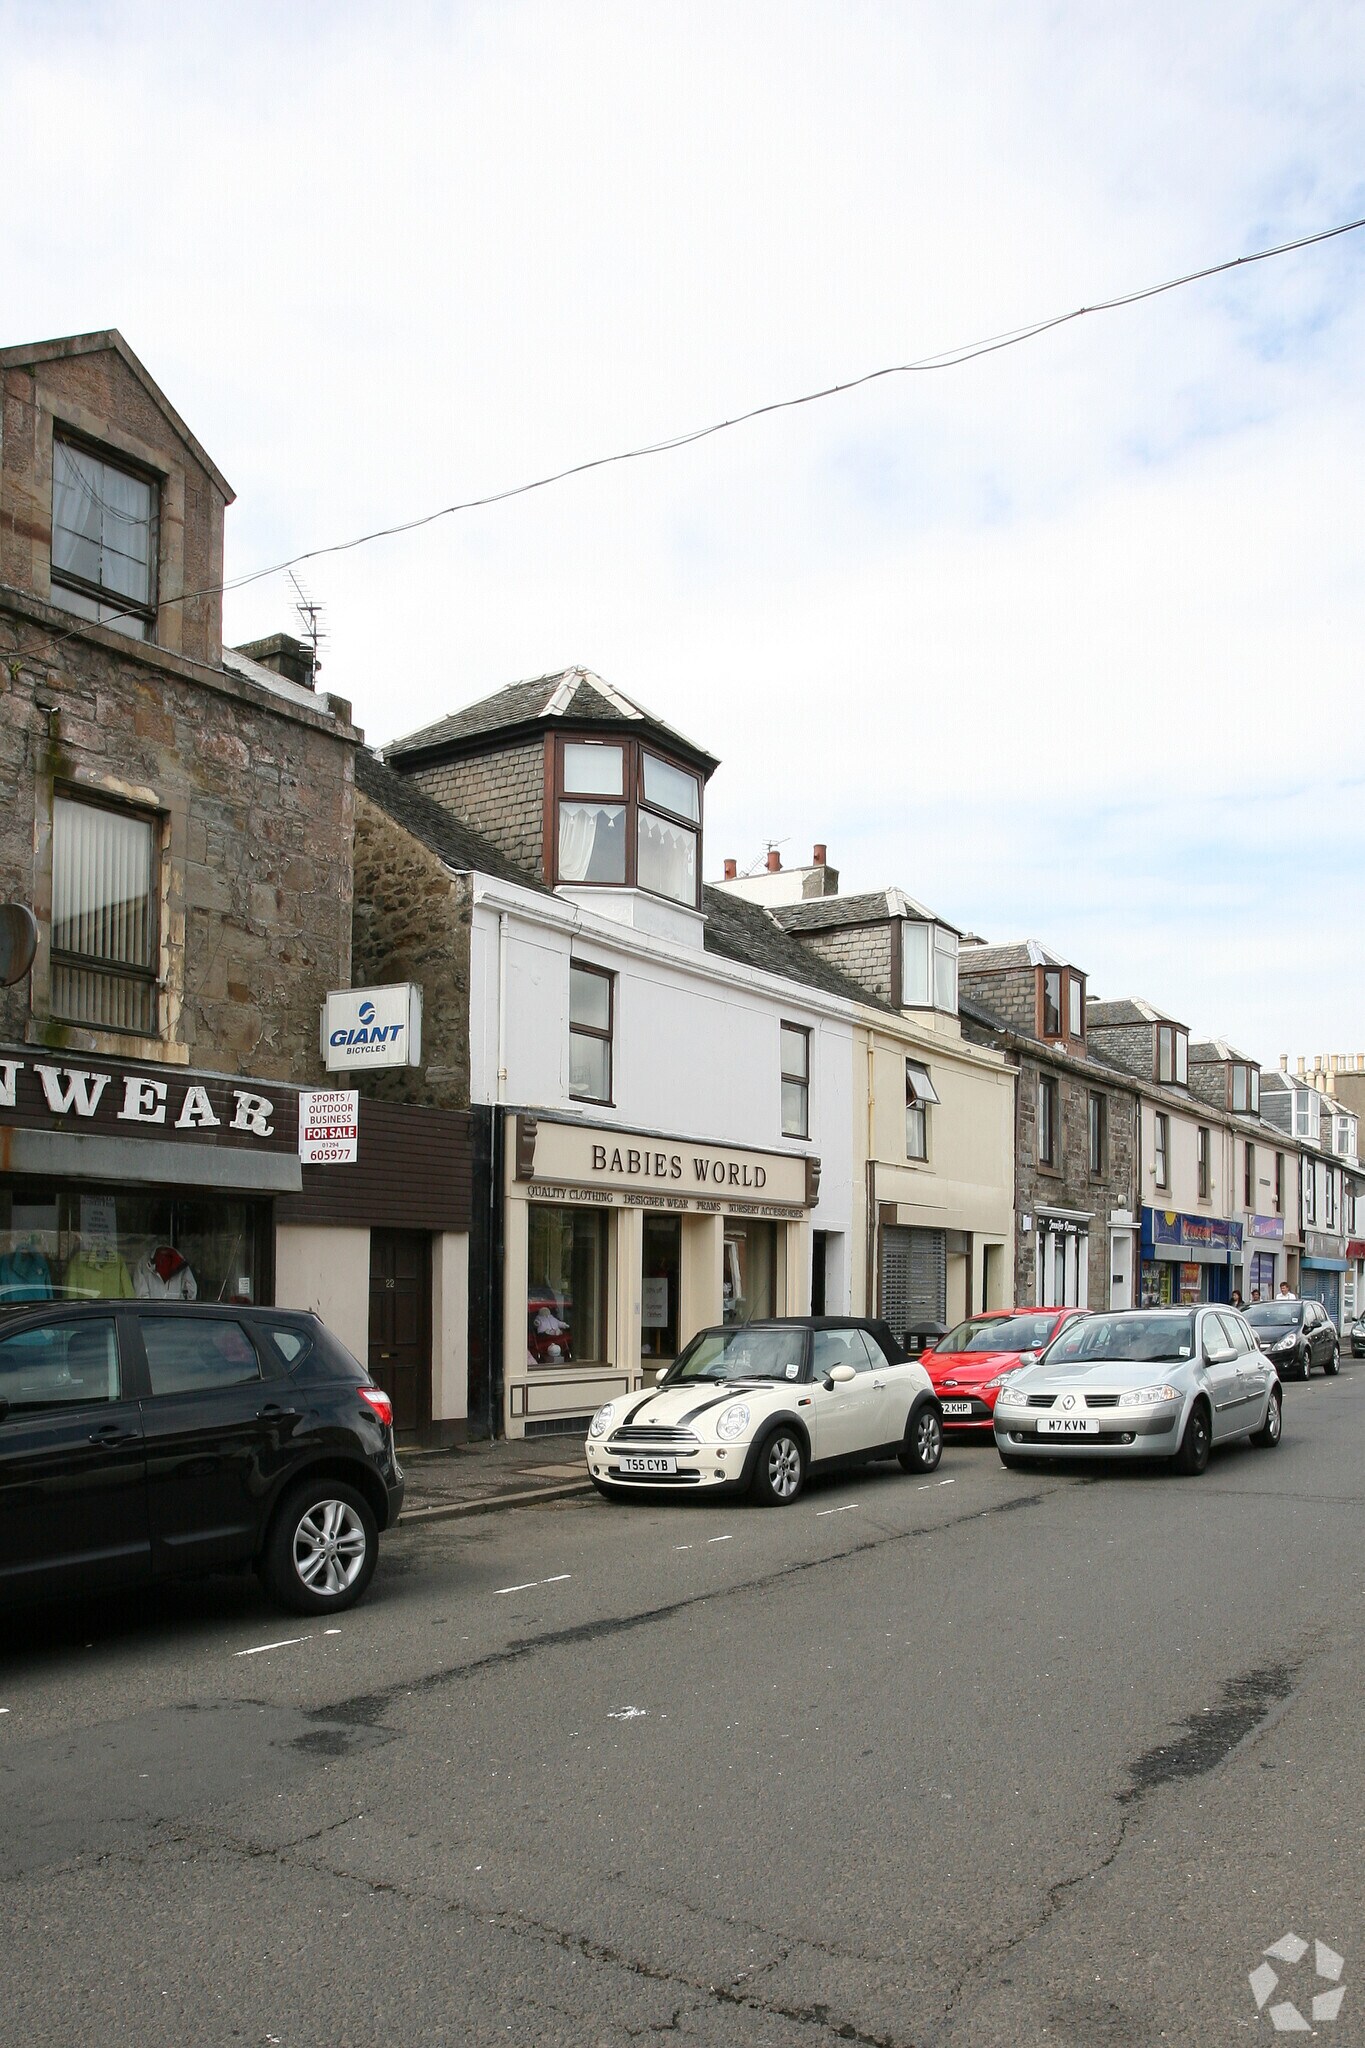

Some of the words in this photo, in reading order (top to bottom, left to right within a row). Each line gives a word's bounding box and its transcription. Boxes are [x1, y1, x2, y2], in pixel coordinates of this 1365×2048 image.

[330, 1025, 404, 1047] GIANT
[346, 1045, 386, 1054] BICYCLES
[312, 1094, 345, 1103] SPORTS
[309, 1104, 353, 1113] OUTDOOR
[310, 1115, 352, 1124] BUSINESS
[307, 1128, 327, 1139] FOR
[329, 1127, 354, 1138] SALE
[310, 1149, 351, 1160] 605977
[591, 1144, 683, 1179] BABIES
[693, 1158, 767, 1188] WORLD
[527, 1185, 567, 1199] QUALITY
[569, 1189, 613, 1203] CLOTHING
[624, 1194, 665, 1207] DESIGNER
[667, 1198, 689, 1209] WEAR
[696, 1201, 721, 1211] PRAMS
[729, 1203, 760, 1214] NURSERY
[760, 1206, 804, 1218] ACCESSORIES
[385, 1279, 395, 1288] 22
[951, 1404, 968, 1412] KHP
[1048, 1420, 1061, 1430] M7
[1064, 1420, 1086, 1430] KVN
[625, 1459, 645, 1471] T55
[647, 1460, 668, 1471] CYB
